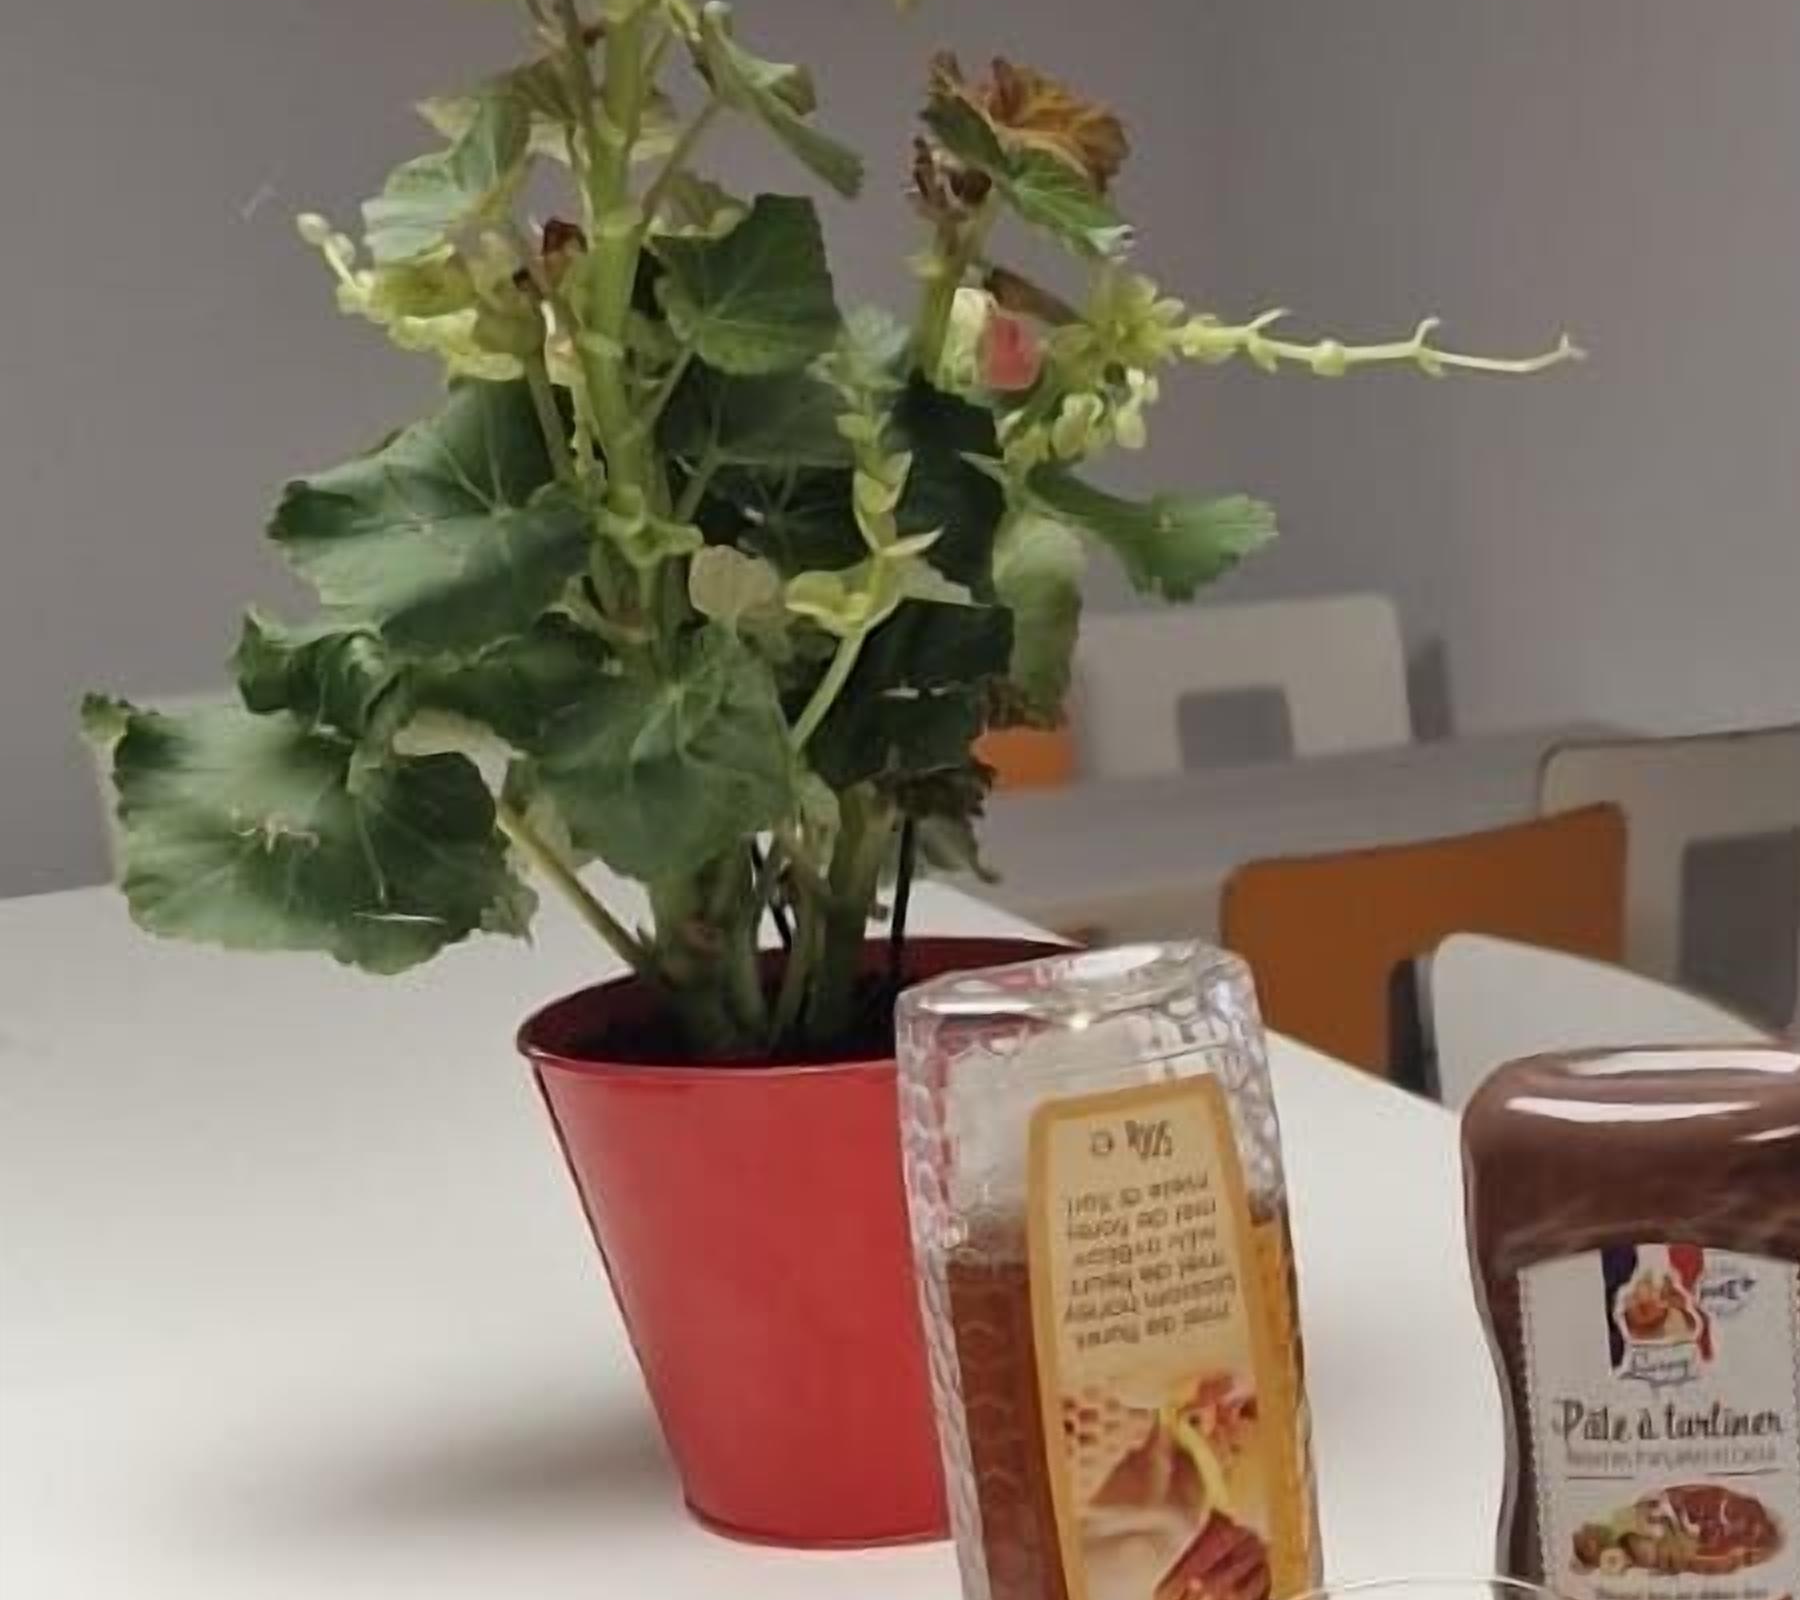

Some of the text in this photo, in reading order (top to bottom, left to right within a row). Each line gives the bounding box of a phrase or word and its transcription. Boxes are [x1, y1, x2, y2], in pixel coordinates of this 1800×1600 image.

[1551, 1398, 1783, 1443] Pâte à tartiner
